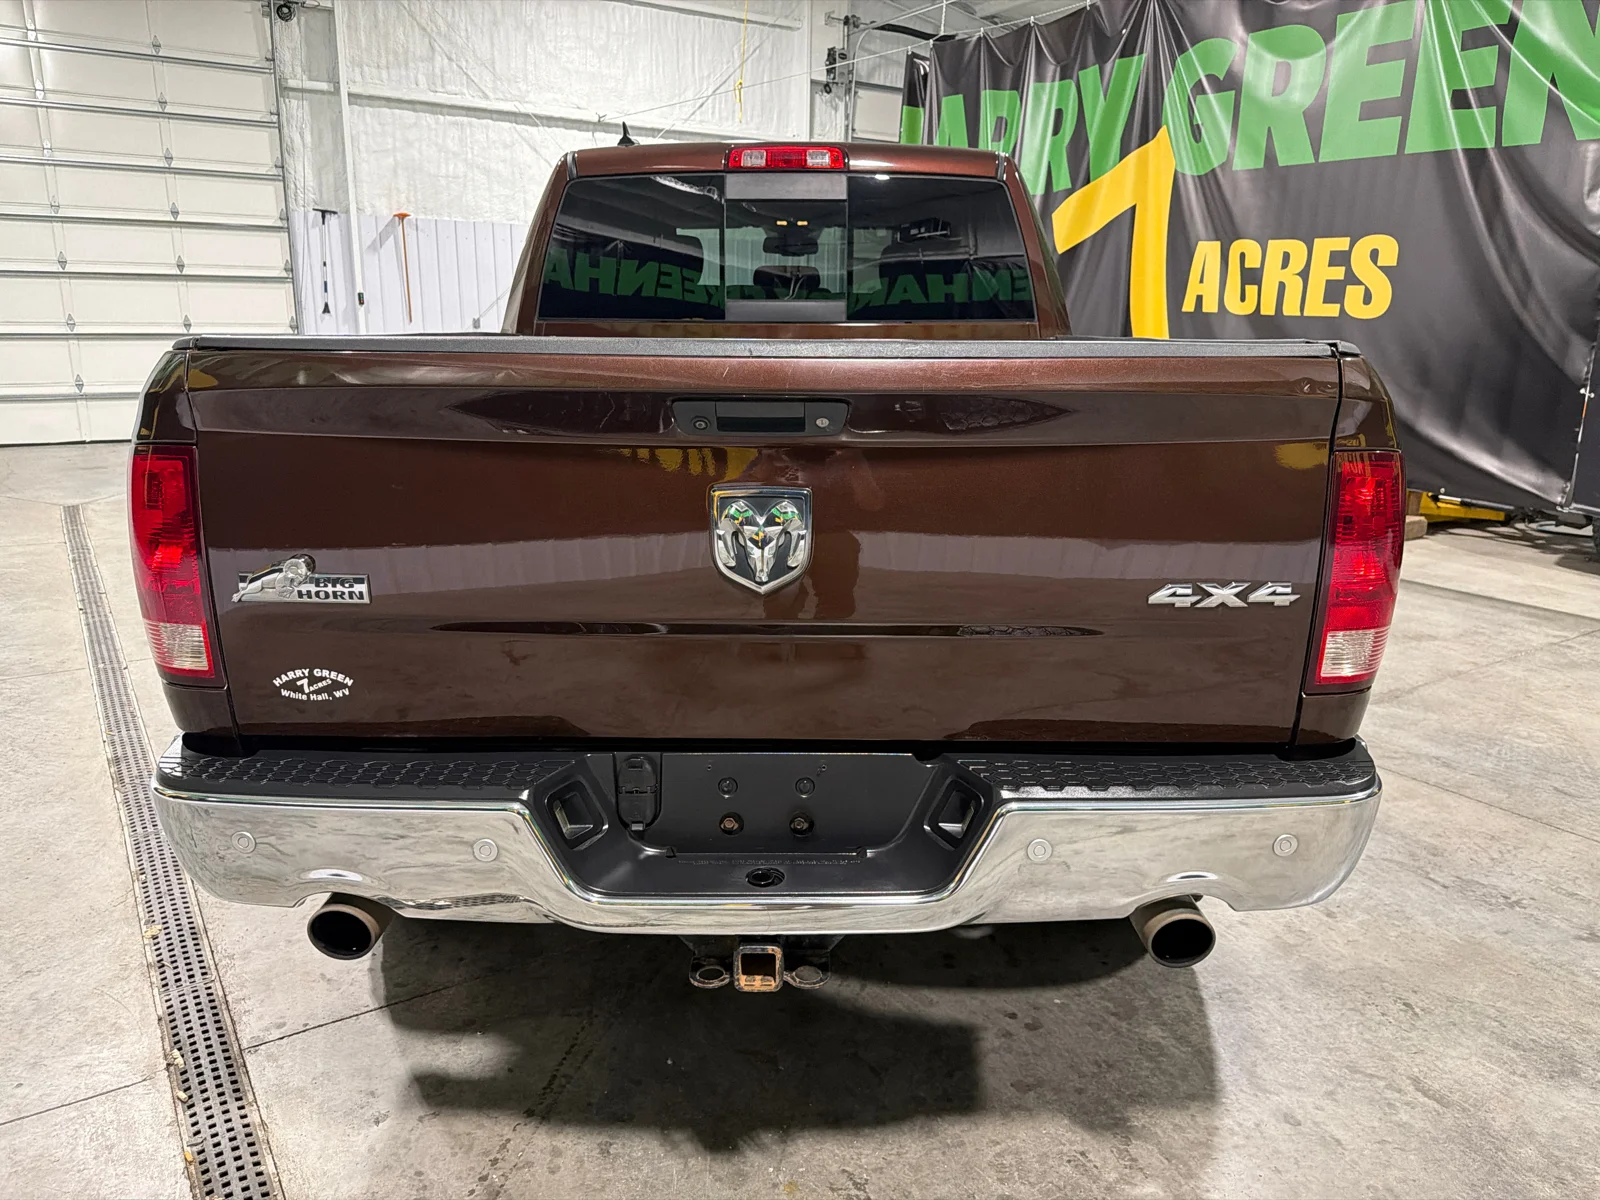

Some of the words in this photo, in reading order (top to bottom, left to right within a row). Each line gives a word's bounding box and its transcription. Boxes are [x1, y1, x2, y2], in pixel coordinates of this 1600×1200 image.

[899, 53, 1147, 196] ARRY
[1162, 0, 1600, 176] GREEN
[1051, 125, 1175, 338] 7
[1182, 234, 1398, 319] ACRES
[315, 577, 354, 588] BIG
[297, 590, 364, 600] HORN
[1148, 581, 1301, 607] 4X4
[272, 668, 310, 687] HARRY
[313, 668, 354, 687] GREEN
[296, 678, 309, 693] 7
[309, 678, 332, 692] ACRES
[281, 688, 308, 700] White
[310, 692, 333, 701] Hall,
[333, 687, 350, 698] WV
